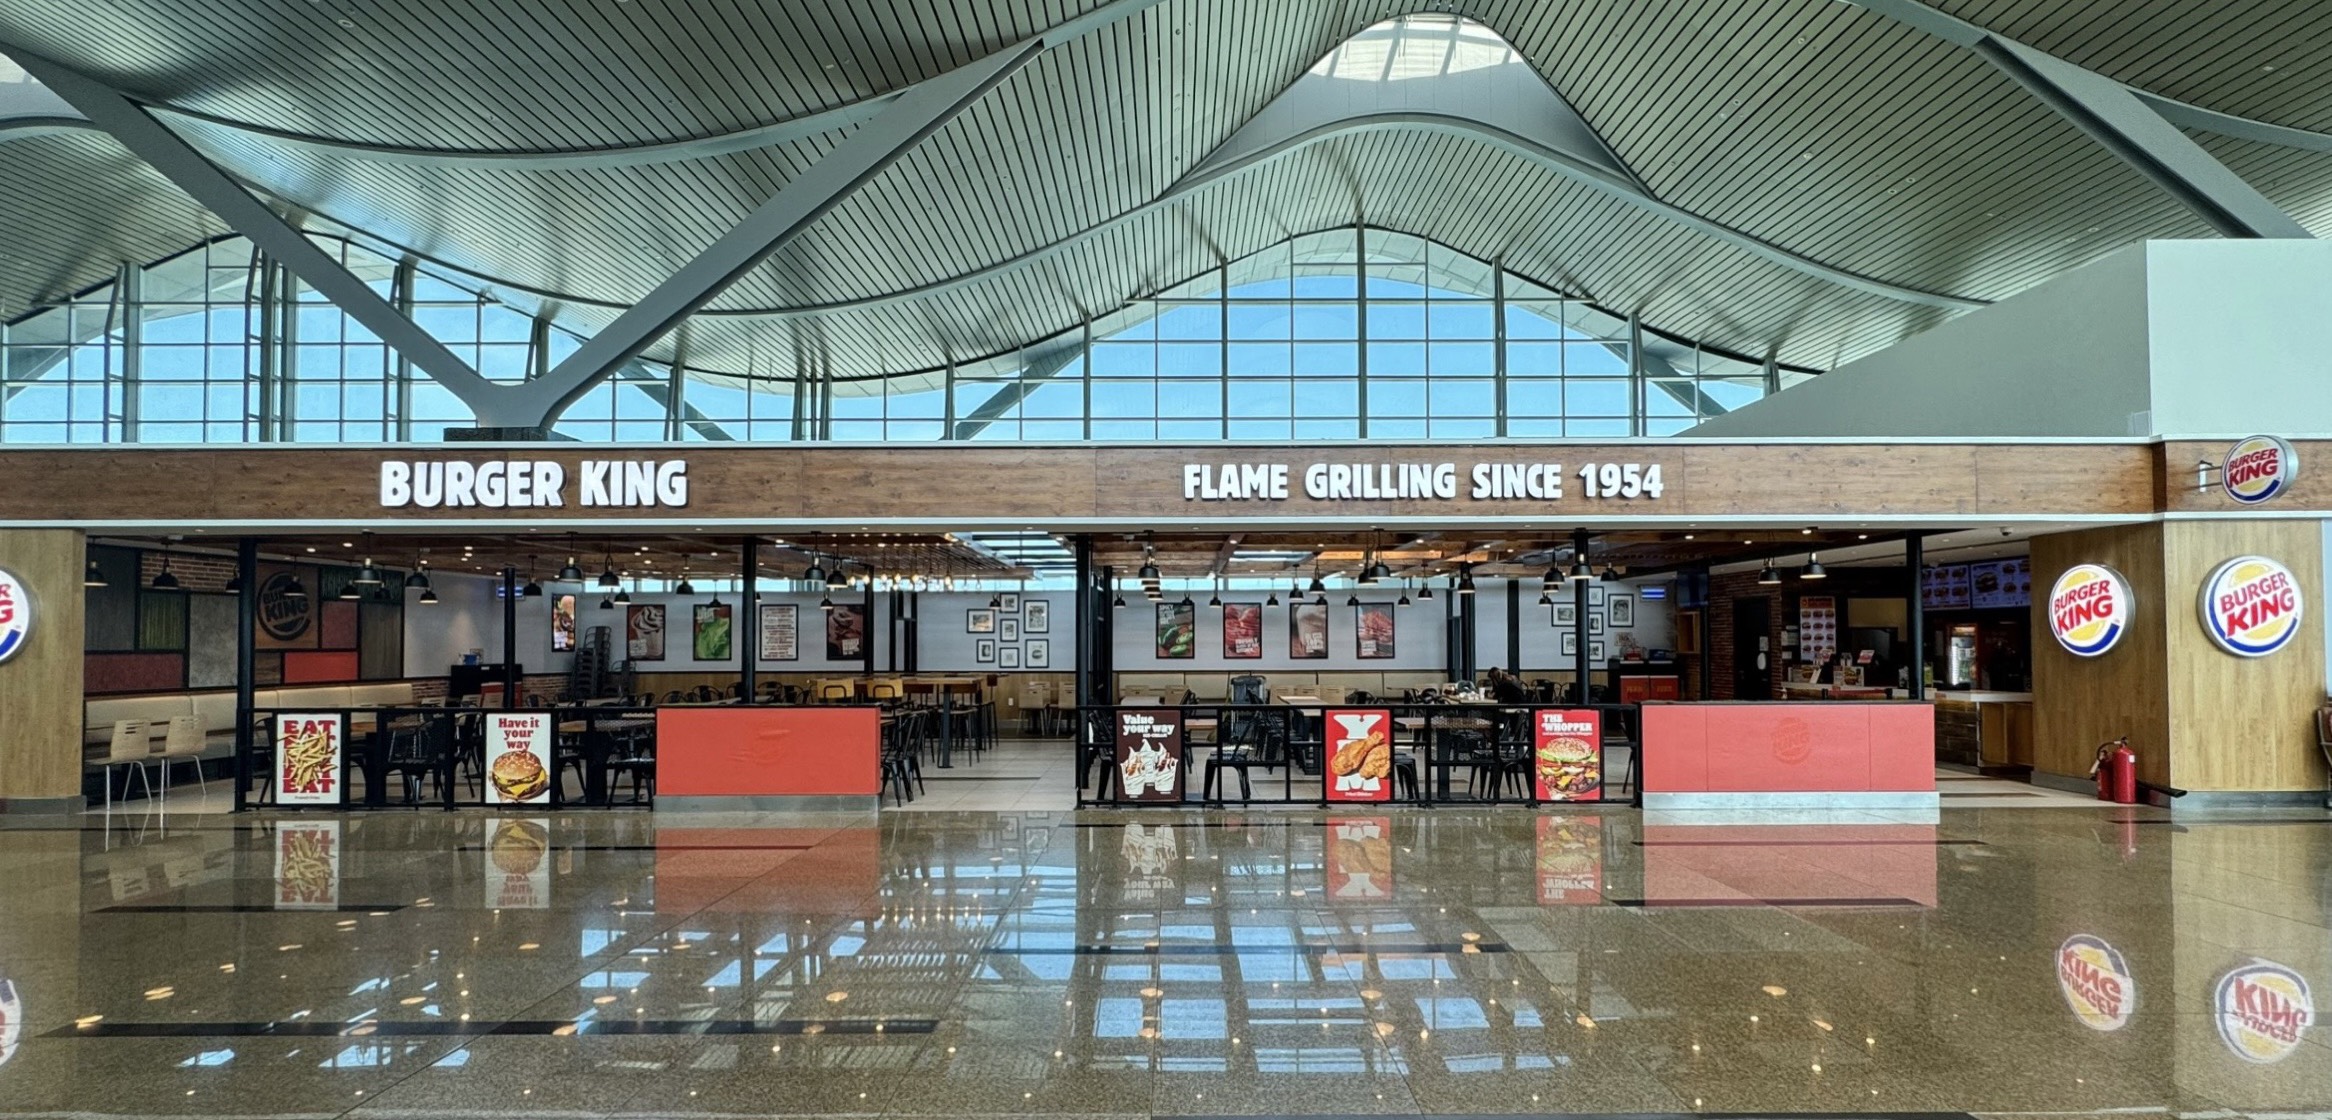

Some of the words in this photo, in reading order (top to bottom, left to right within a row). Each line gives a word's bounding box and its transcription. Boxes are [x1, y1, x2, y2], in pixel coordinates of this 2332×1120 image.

[2228, 448, 2278, 472] BURGER
[380, 460, 564, 508] BURGER
[580, 460, 689, 507] KING
[1184, 464, 1289, 500] FLAME
[1305, 463, 1457, 499] GRILLING
[1471, 463, 1563, 498] SINCE
[1579, 463, 1664, 498] 1954
[2229, 460, 2278, 488] KING
[2054, 580, 2110, 615] BURGER
[2220, 572, 2289, 614] BURGER
[265, 597, 309, 622] KING
[2056, 595, 2113, 636] KING
[2227, 587, 2295, 637] KING
[283, 720, 336, 736] EAT
[498, 718, 529, 728] Have
[530, 717, 540, 728] it
[1122, 714, 1154, 724] Value
[1122, 725, 1151, 736] your
[1152, 724, 1175, 735] way
[1541, 723, 1593, 732] WHOPPER
[1542, 714, 1563, 723] THE
[504, 730, 534, 740] your
[507, 741, 531, 752] way
